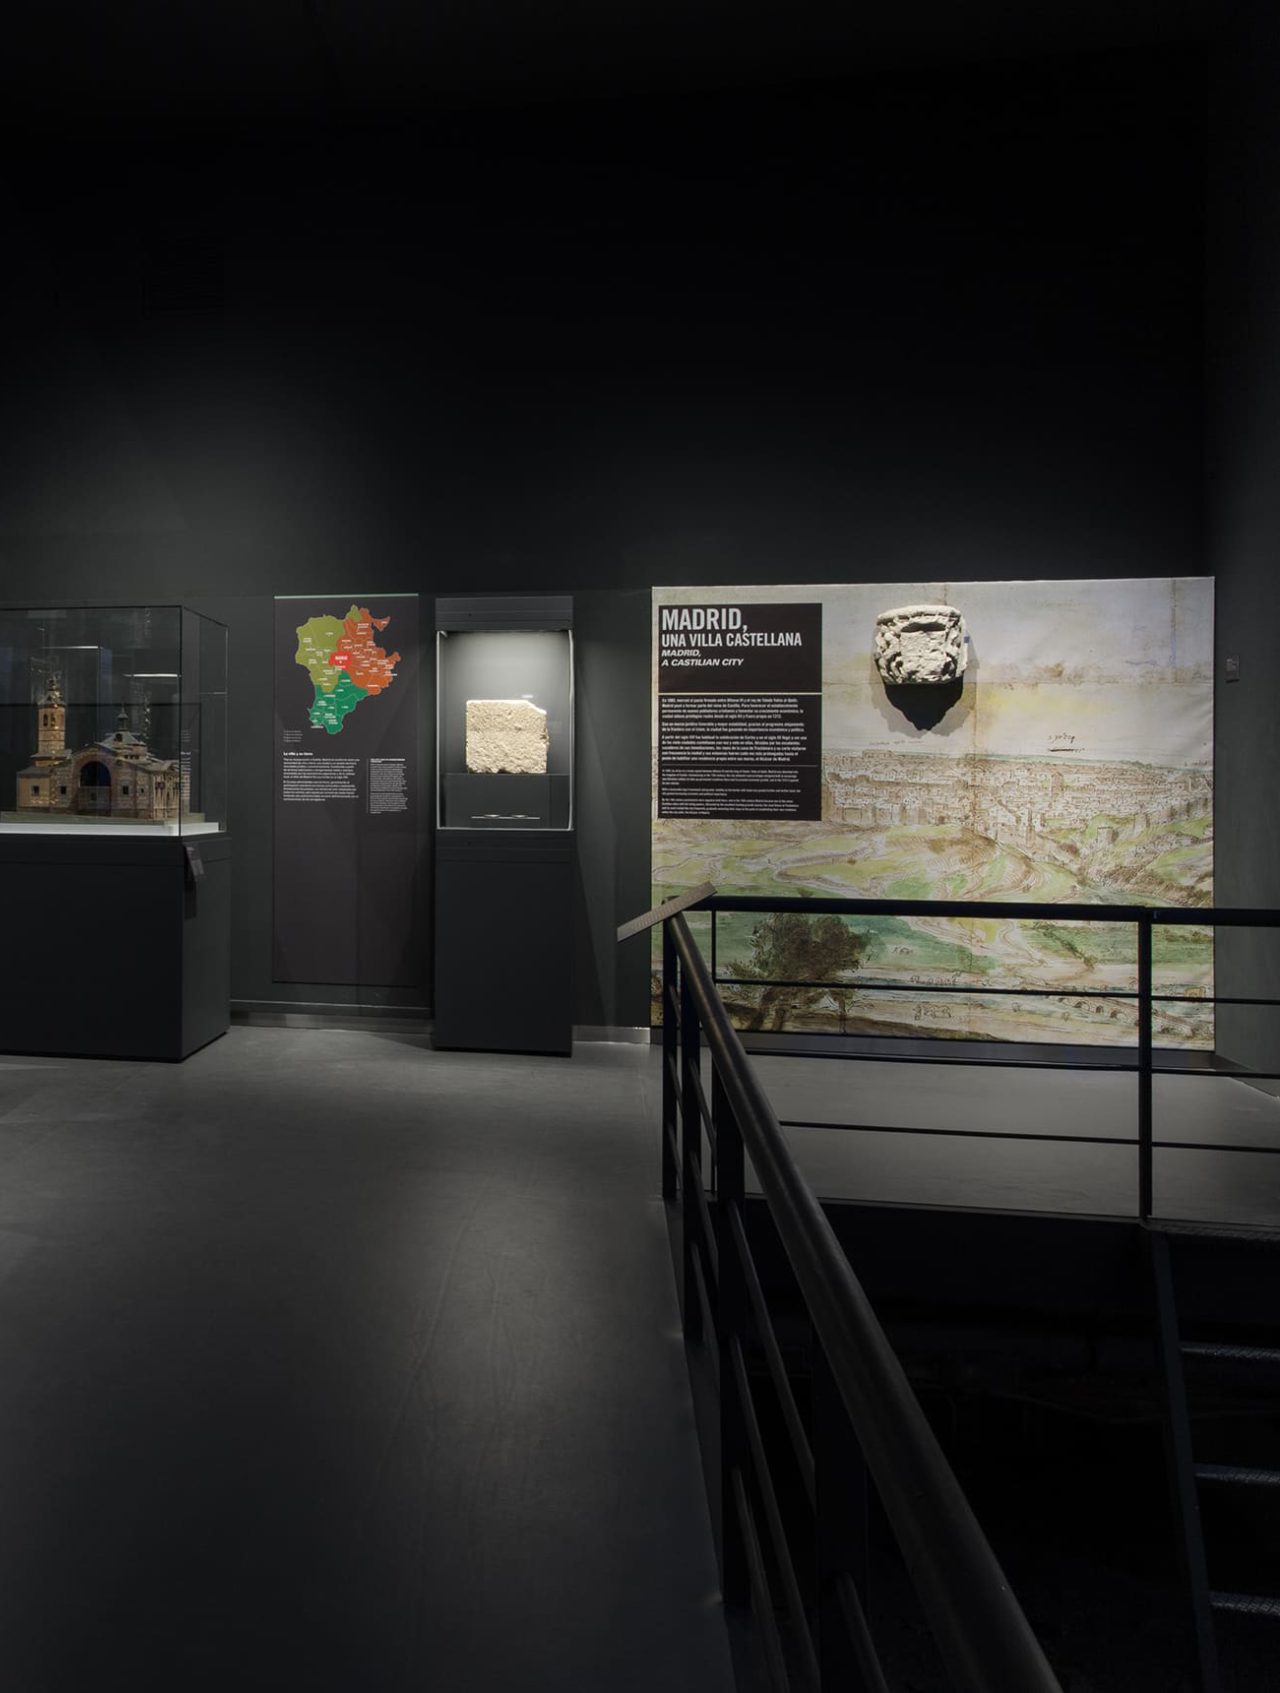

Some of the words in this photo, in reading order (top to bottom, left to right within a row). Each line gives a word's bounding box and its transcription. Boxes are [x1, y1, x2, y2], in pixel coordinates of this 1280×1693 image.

[662, 607, 748, 632] MADRID,
[662, 633, 686, 647] UNA
[689, 633, 723, 647] VILLA
[726, 632, 802, 647] CASTELLANA
[661, 649, 701, 657] MADRID,
[671, 658, 720, 667] CASTILIAN
[721, 658, 744, 666] CITY
